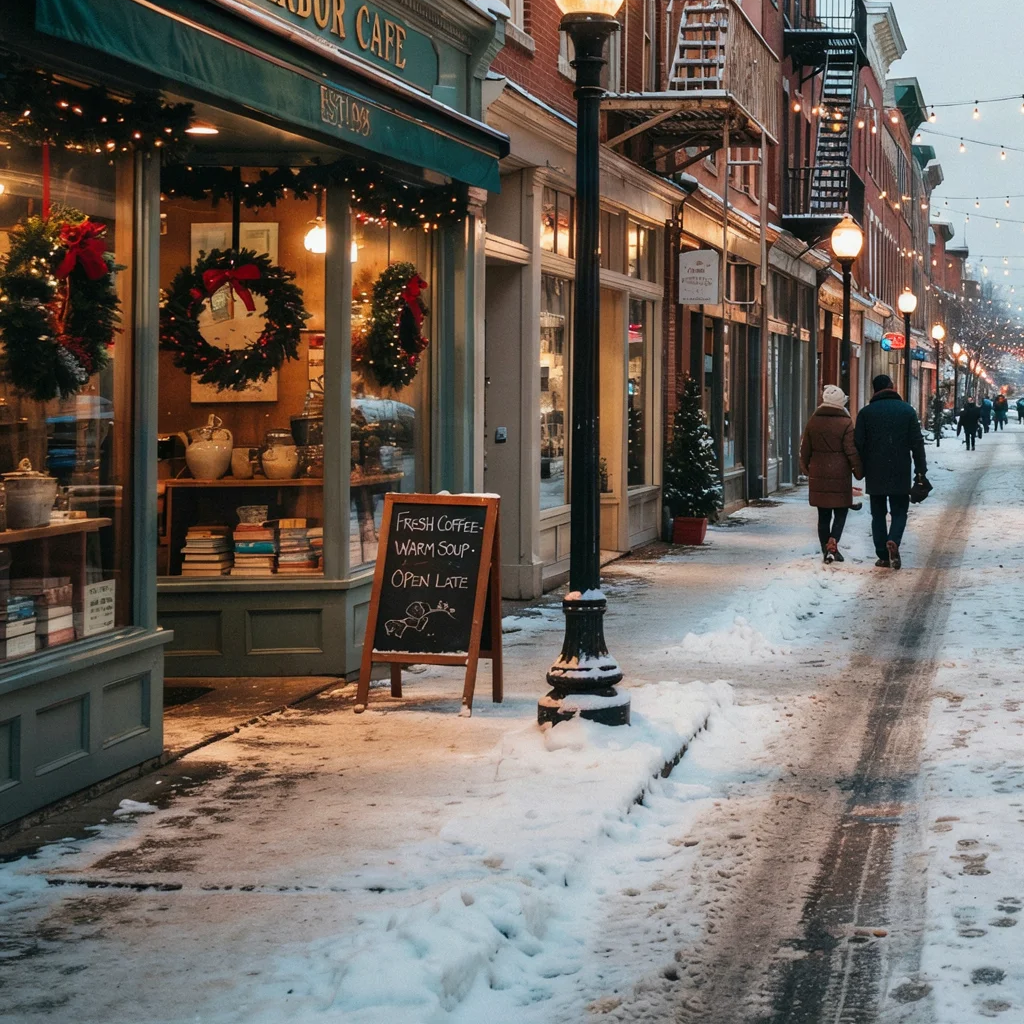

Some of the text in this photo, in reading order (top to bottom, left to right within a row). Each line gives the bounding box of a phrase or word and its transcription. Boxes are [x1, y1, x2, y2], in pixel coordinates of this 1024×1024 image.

[356, 5, 407, 69] CAFE
[396, 511, 434, 532] FRESH
[394, 539, 435, 558] WARM
[391, 569, 468, 589] OPEN LATE
